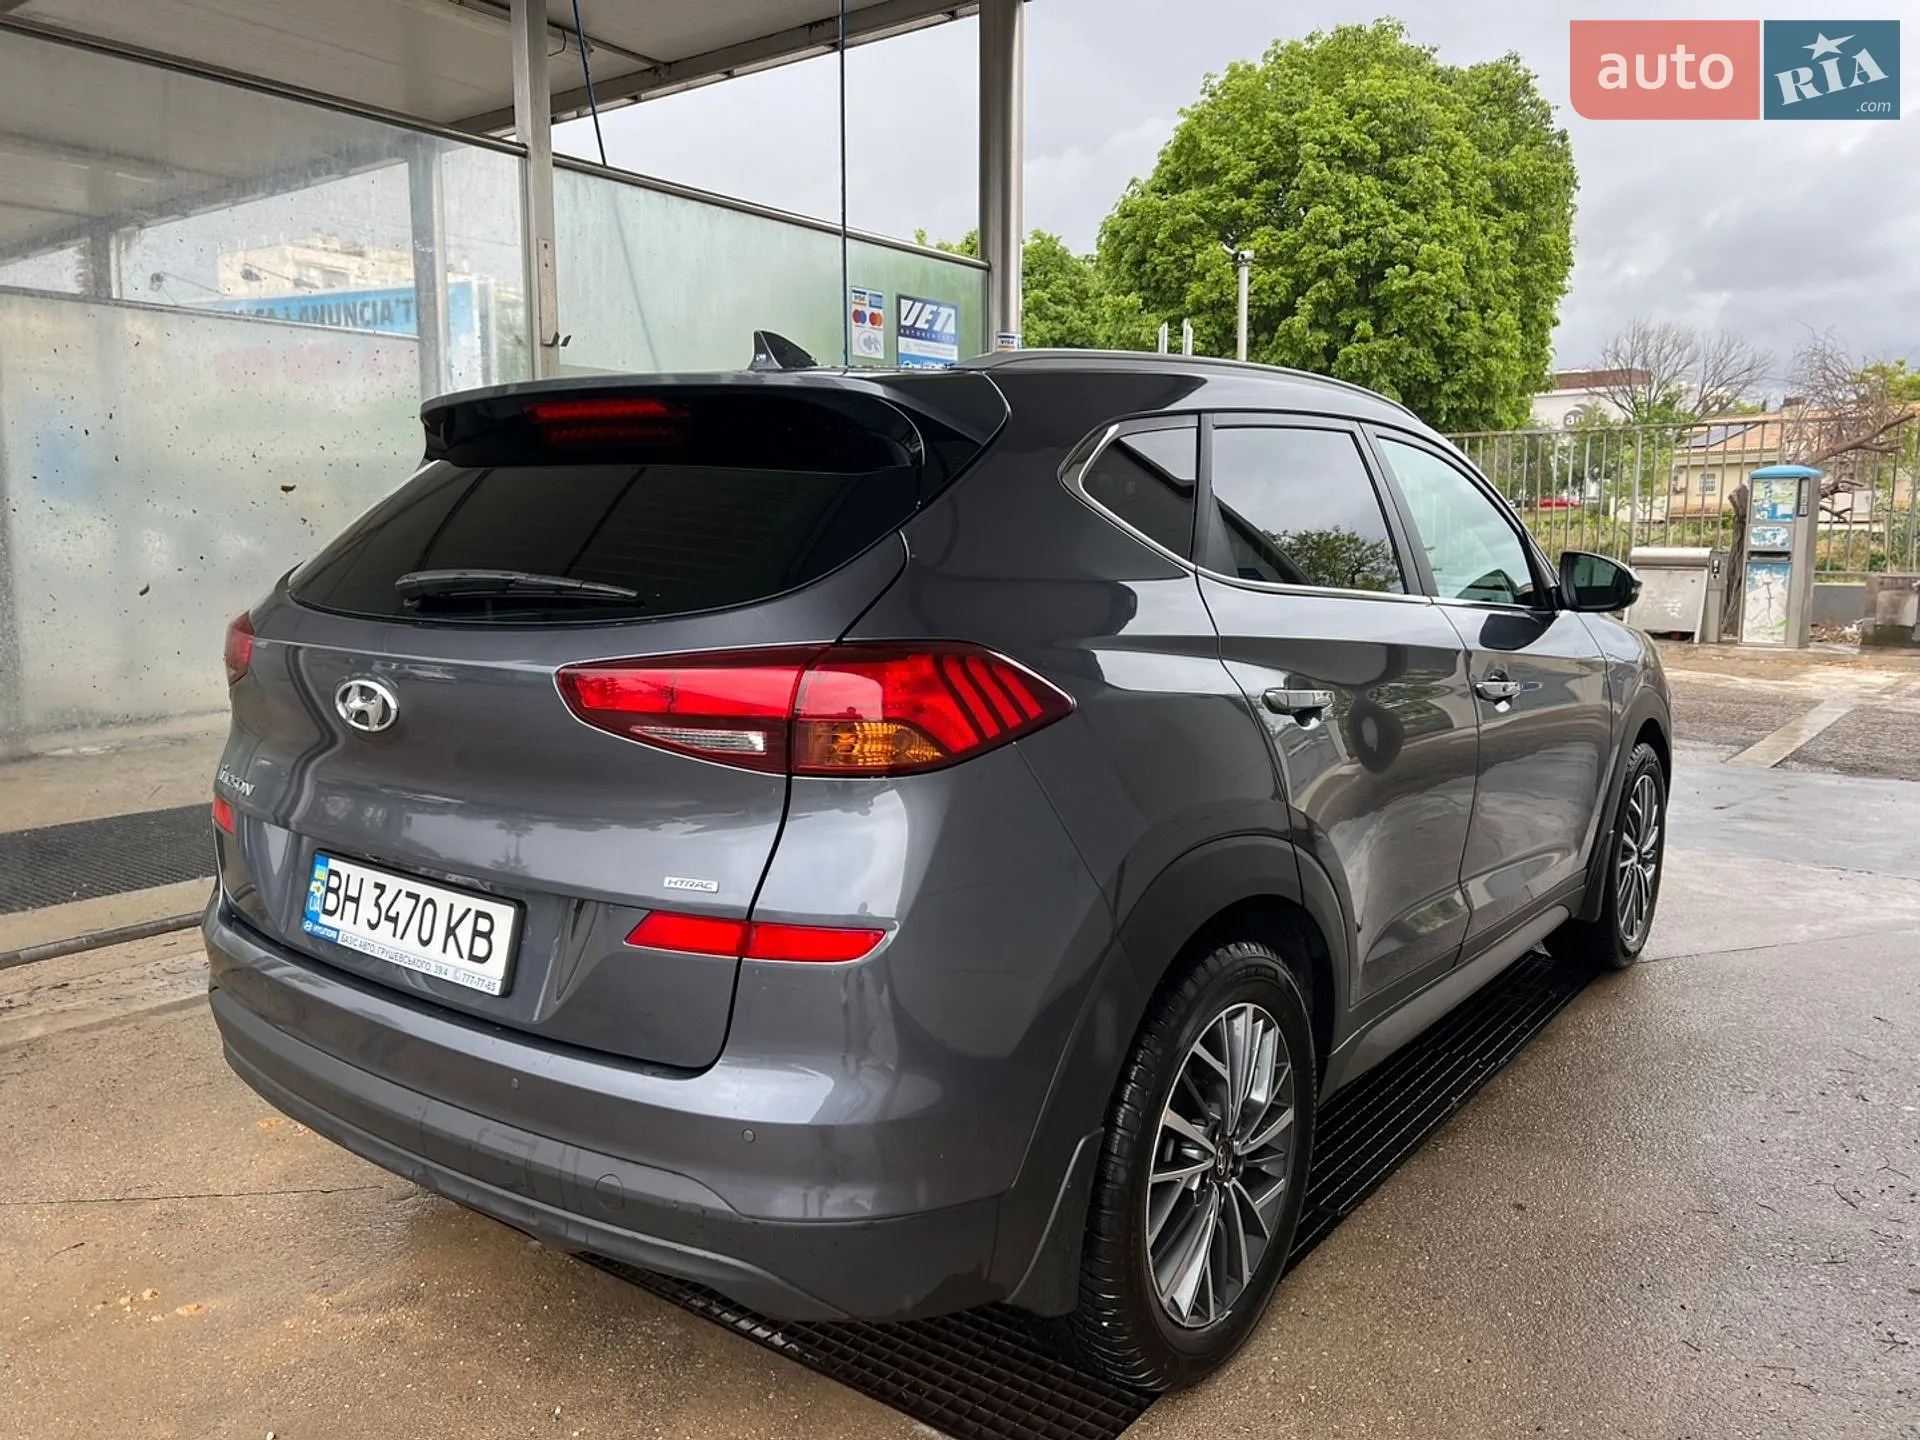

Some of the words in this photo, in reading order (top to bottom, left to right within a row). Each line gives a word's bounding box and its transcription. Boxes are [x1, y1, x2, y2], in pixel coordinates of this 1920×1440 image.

[666, 878, 715, 891] HTRAC
[322, 868, 363, 925] BH
[367, 881, 437, 947] 3470
[442, 903, 495, 964] KB
